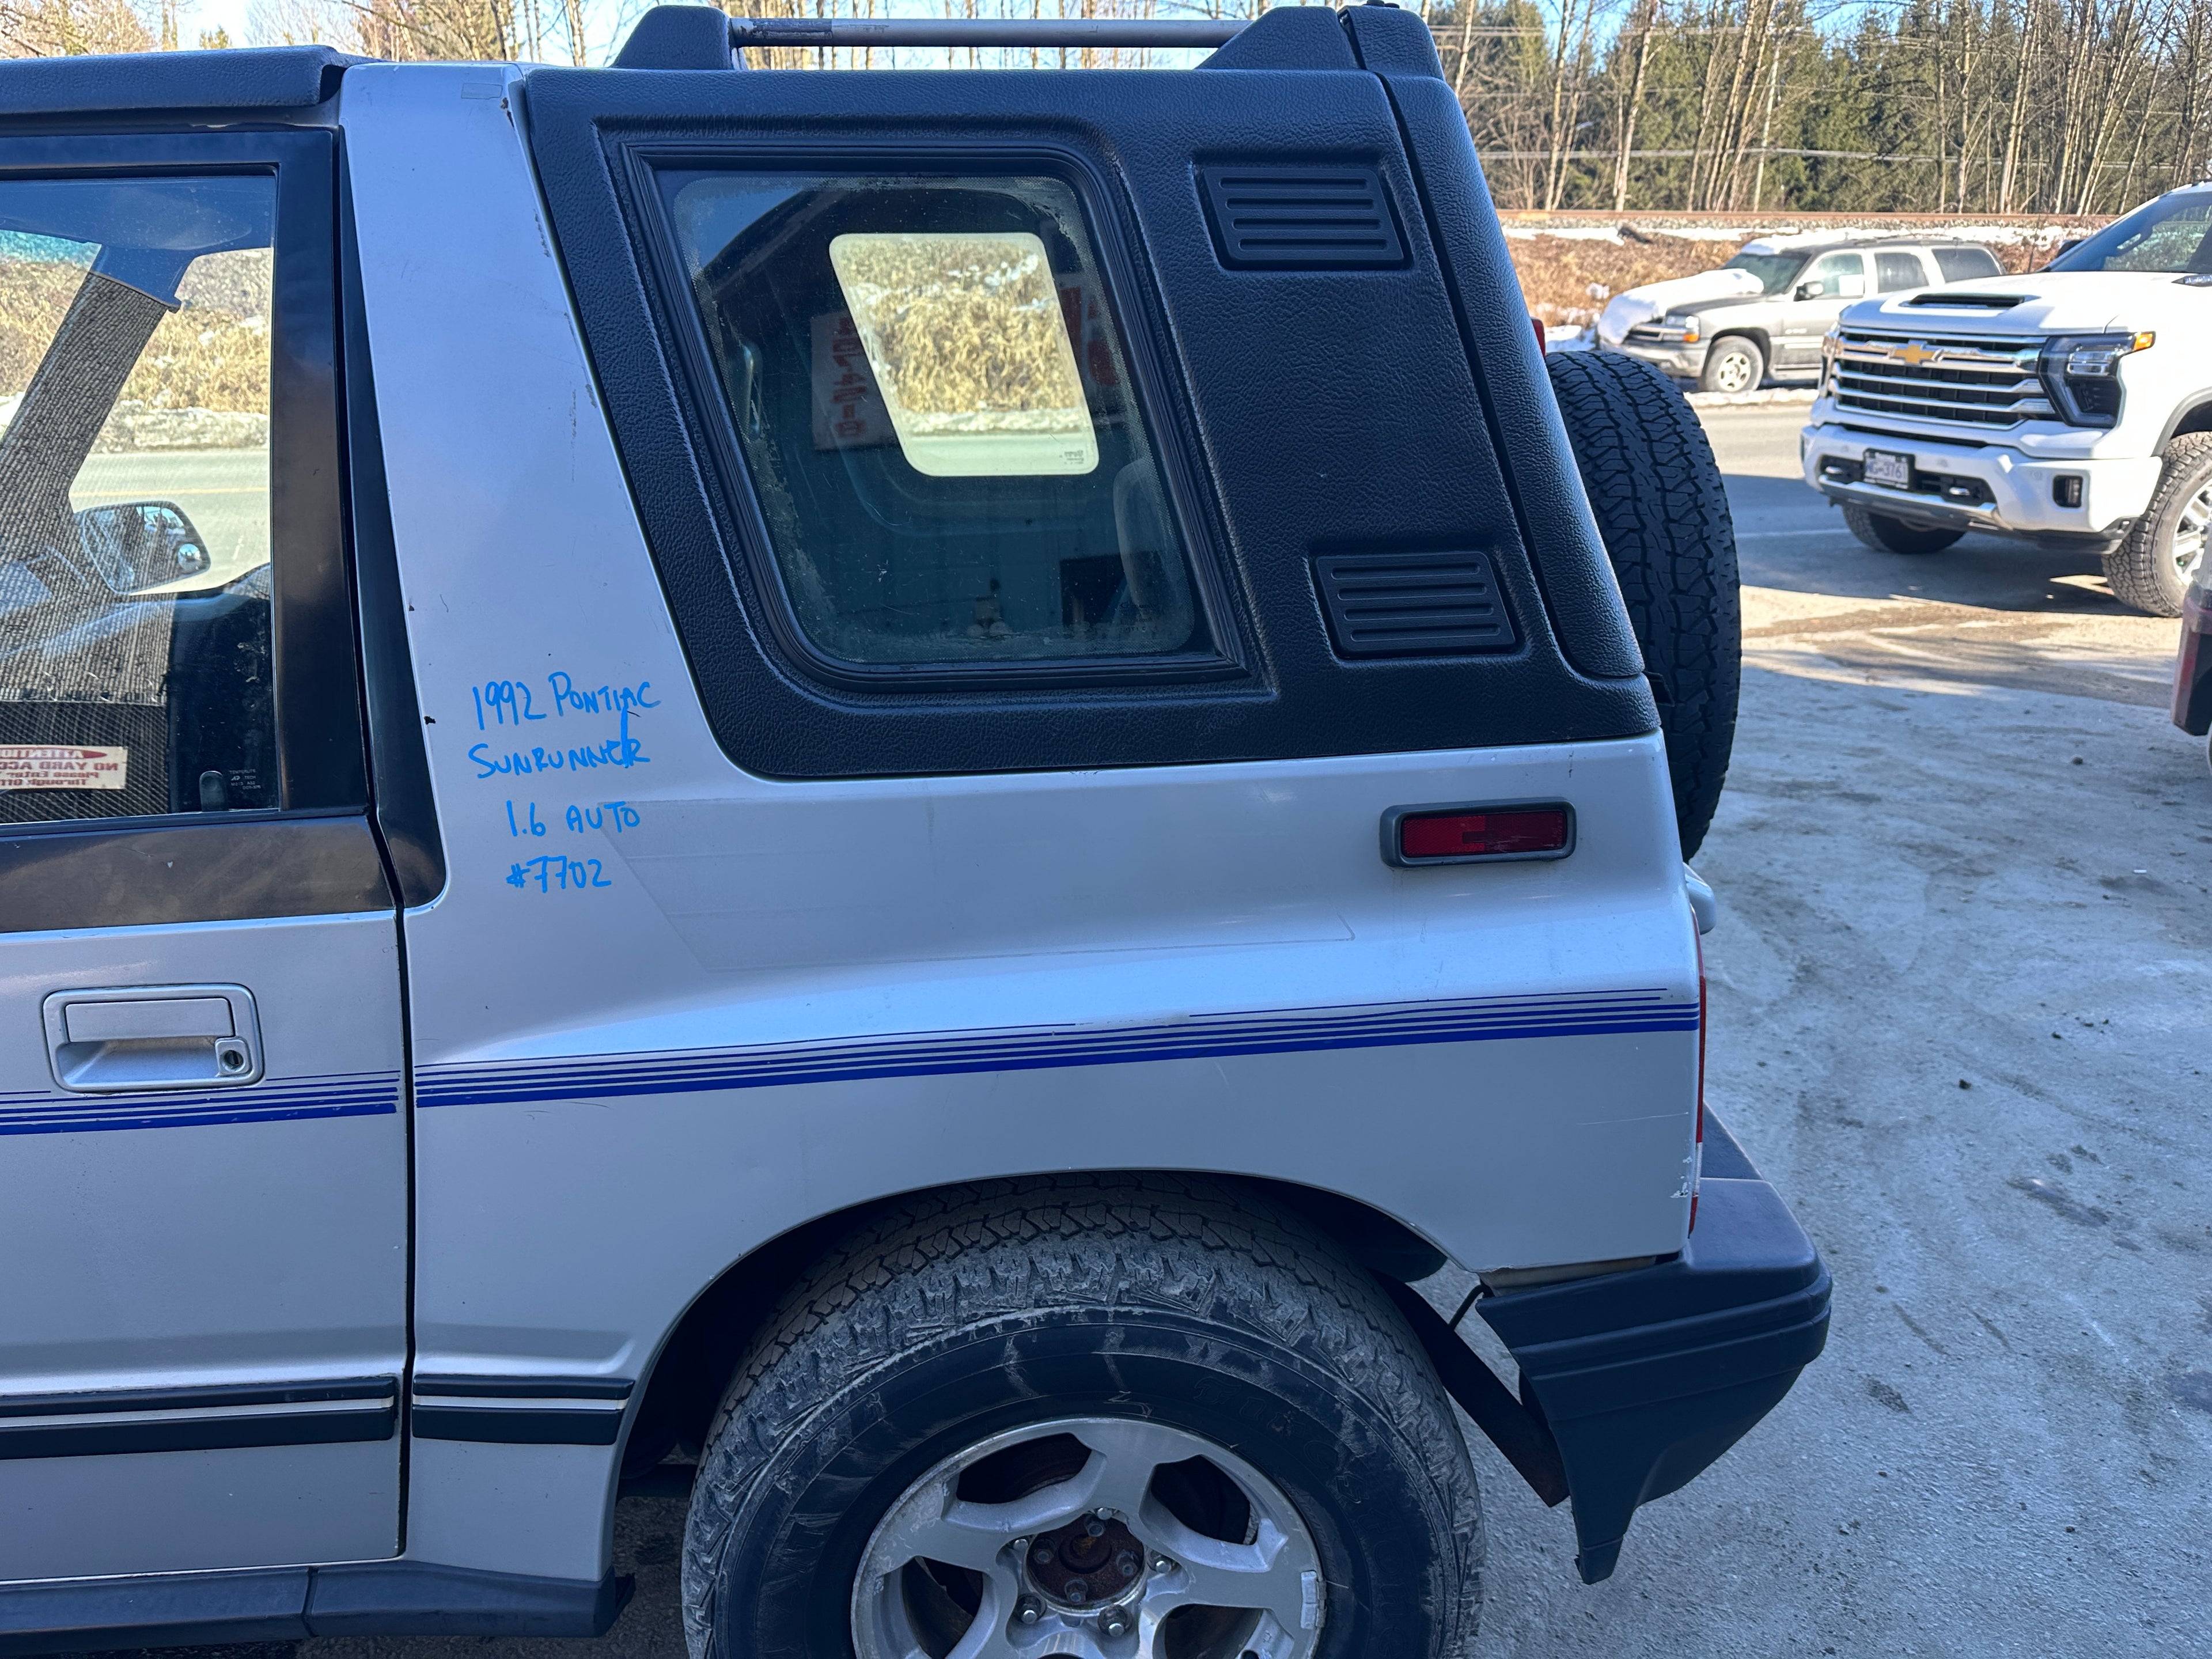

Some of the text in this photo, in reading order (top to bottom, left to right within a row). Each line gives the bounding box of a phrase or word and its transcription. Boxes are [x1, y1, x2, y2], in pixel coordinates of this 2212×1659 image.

[472, 671, 661, 730] 1992 PONTIAC
[468, 738, 650, 779] SUNRUNNER
[506, 800, 641, 836] 1.6 AUTO
[506, 855, 612, 893] #7702
